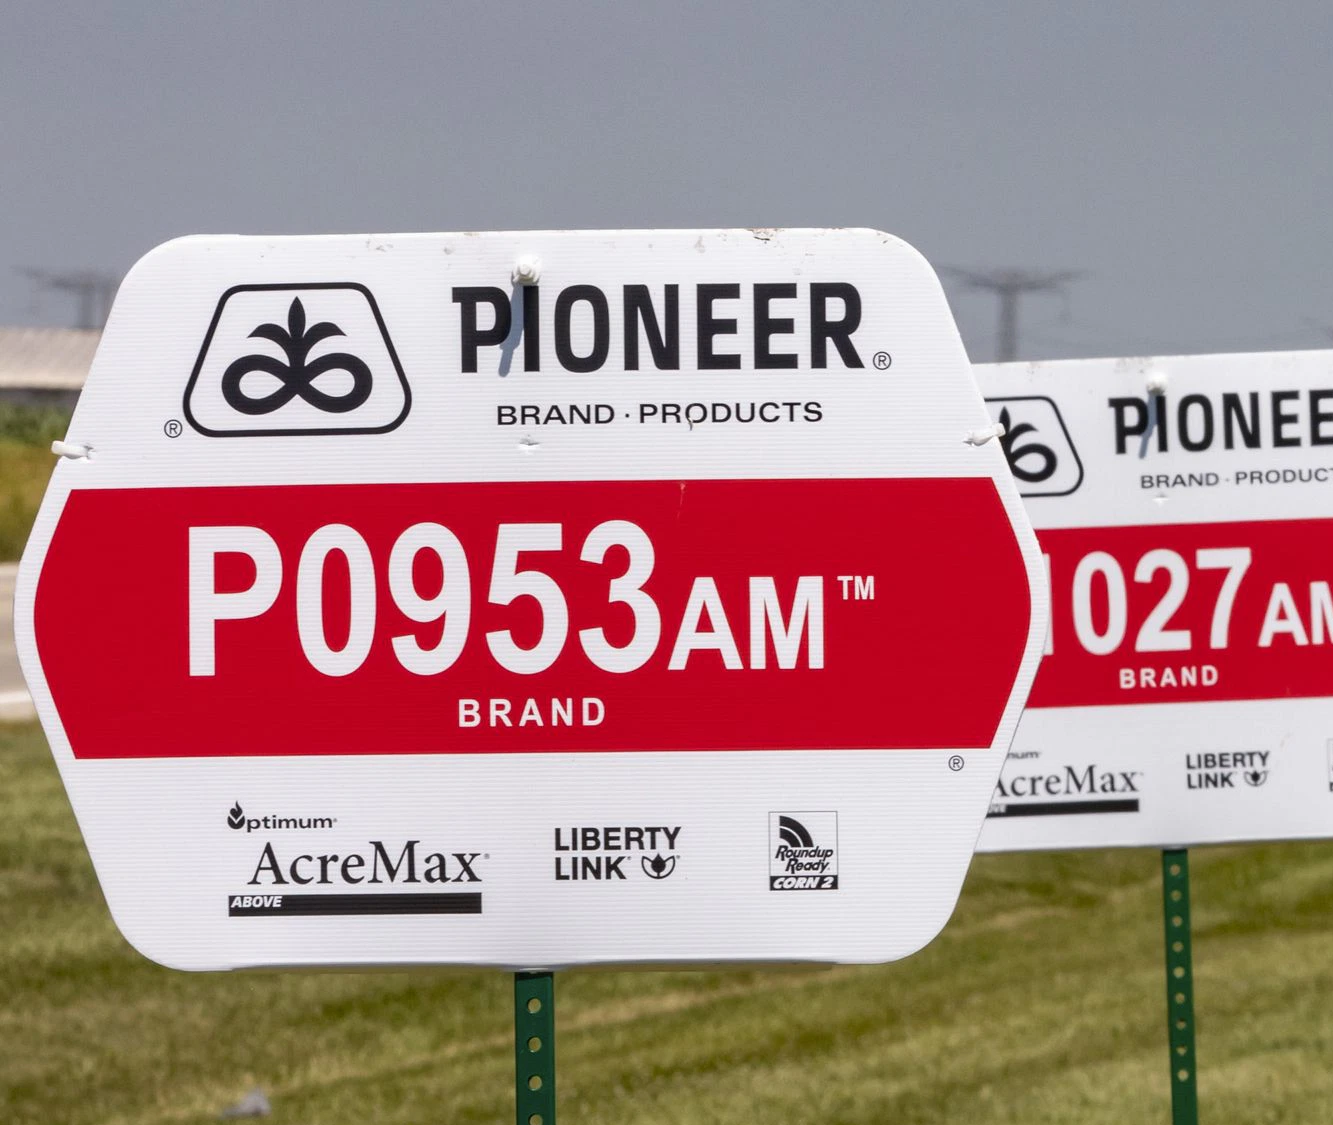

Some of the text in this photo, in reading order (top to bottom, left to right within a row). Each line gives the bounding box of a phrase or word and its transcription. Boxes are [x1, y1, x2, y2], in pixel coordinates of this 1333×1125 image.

[497, 402, 823, 425] BRAND PRODUCTS
[1140, 472, 1219, 489] BRAND
[1119, 665, 1218, 689] BRAND
[458, 697, 606, 727] BRAND
[1186, 751, 1270, 770] LIBERTY
[1187, 772, 1235, 789] LINK
[554, 826, 682, 851] LIBERTY
[775, 845, 834, 861] Roundup
[554, 856, 627, 880] LINK
[785, 858, 829, 874] Ready
[773, 876, 834, 889] CORN 2
[231, 895, 282, 908] ABOVE
